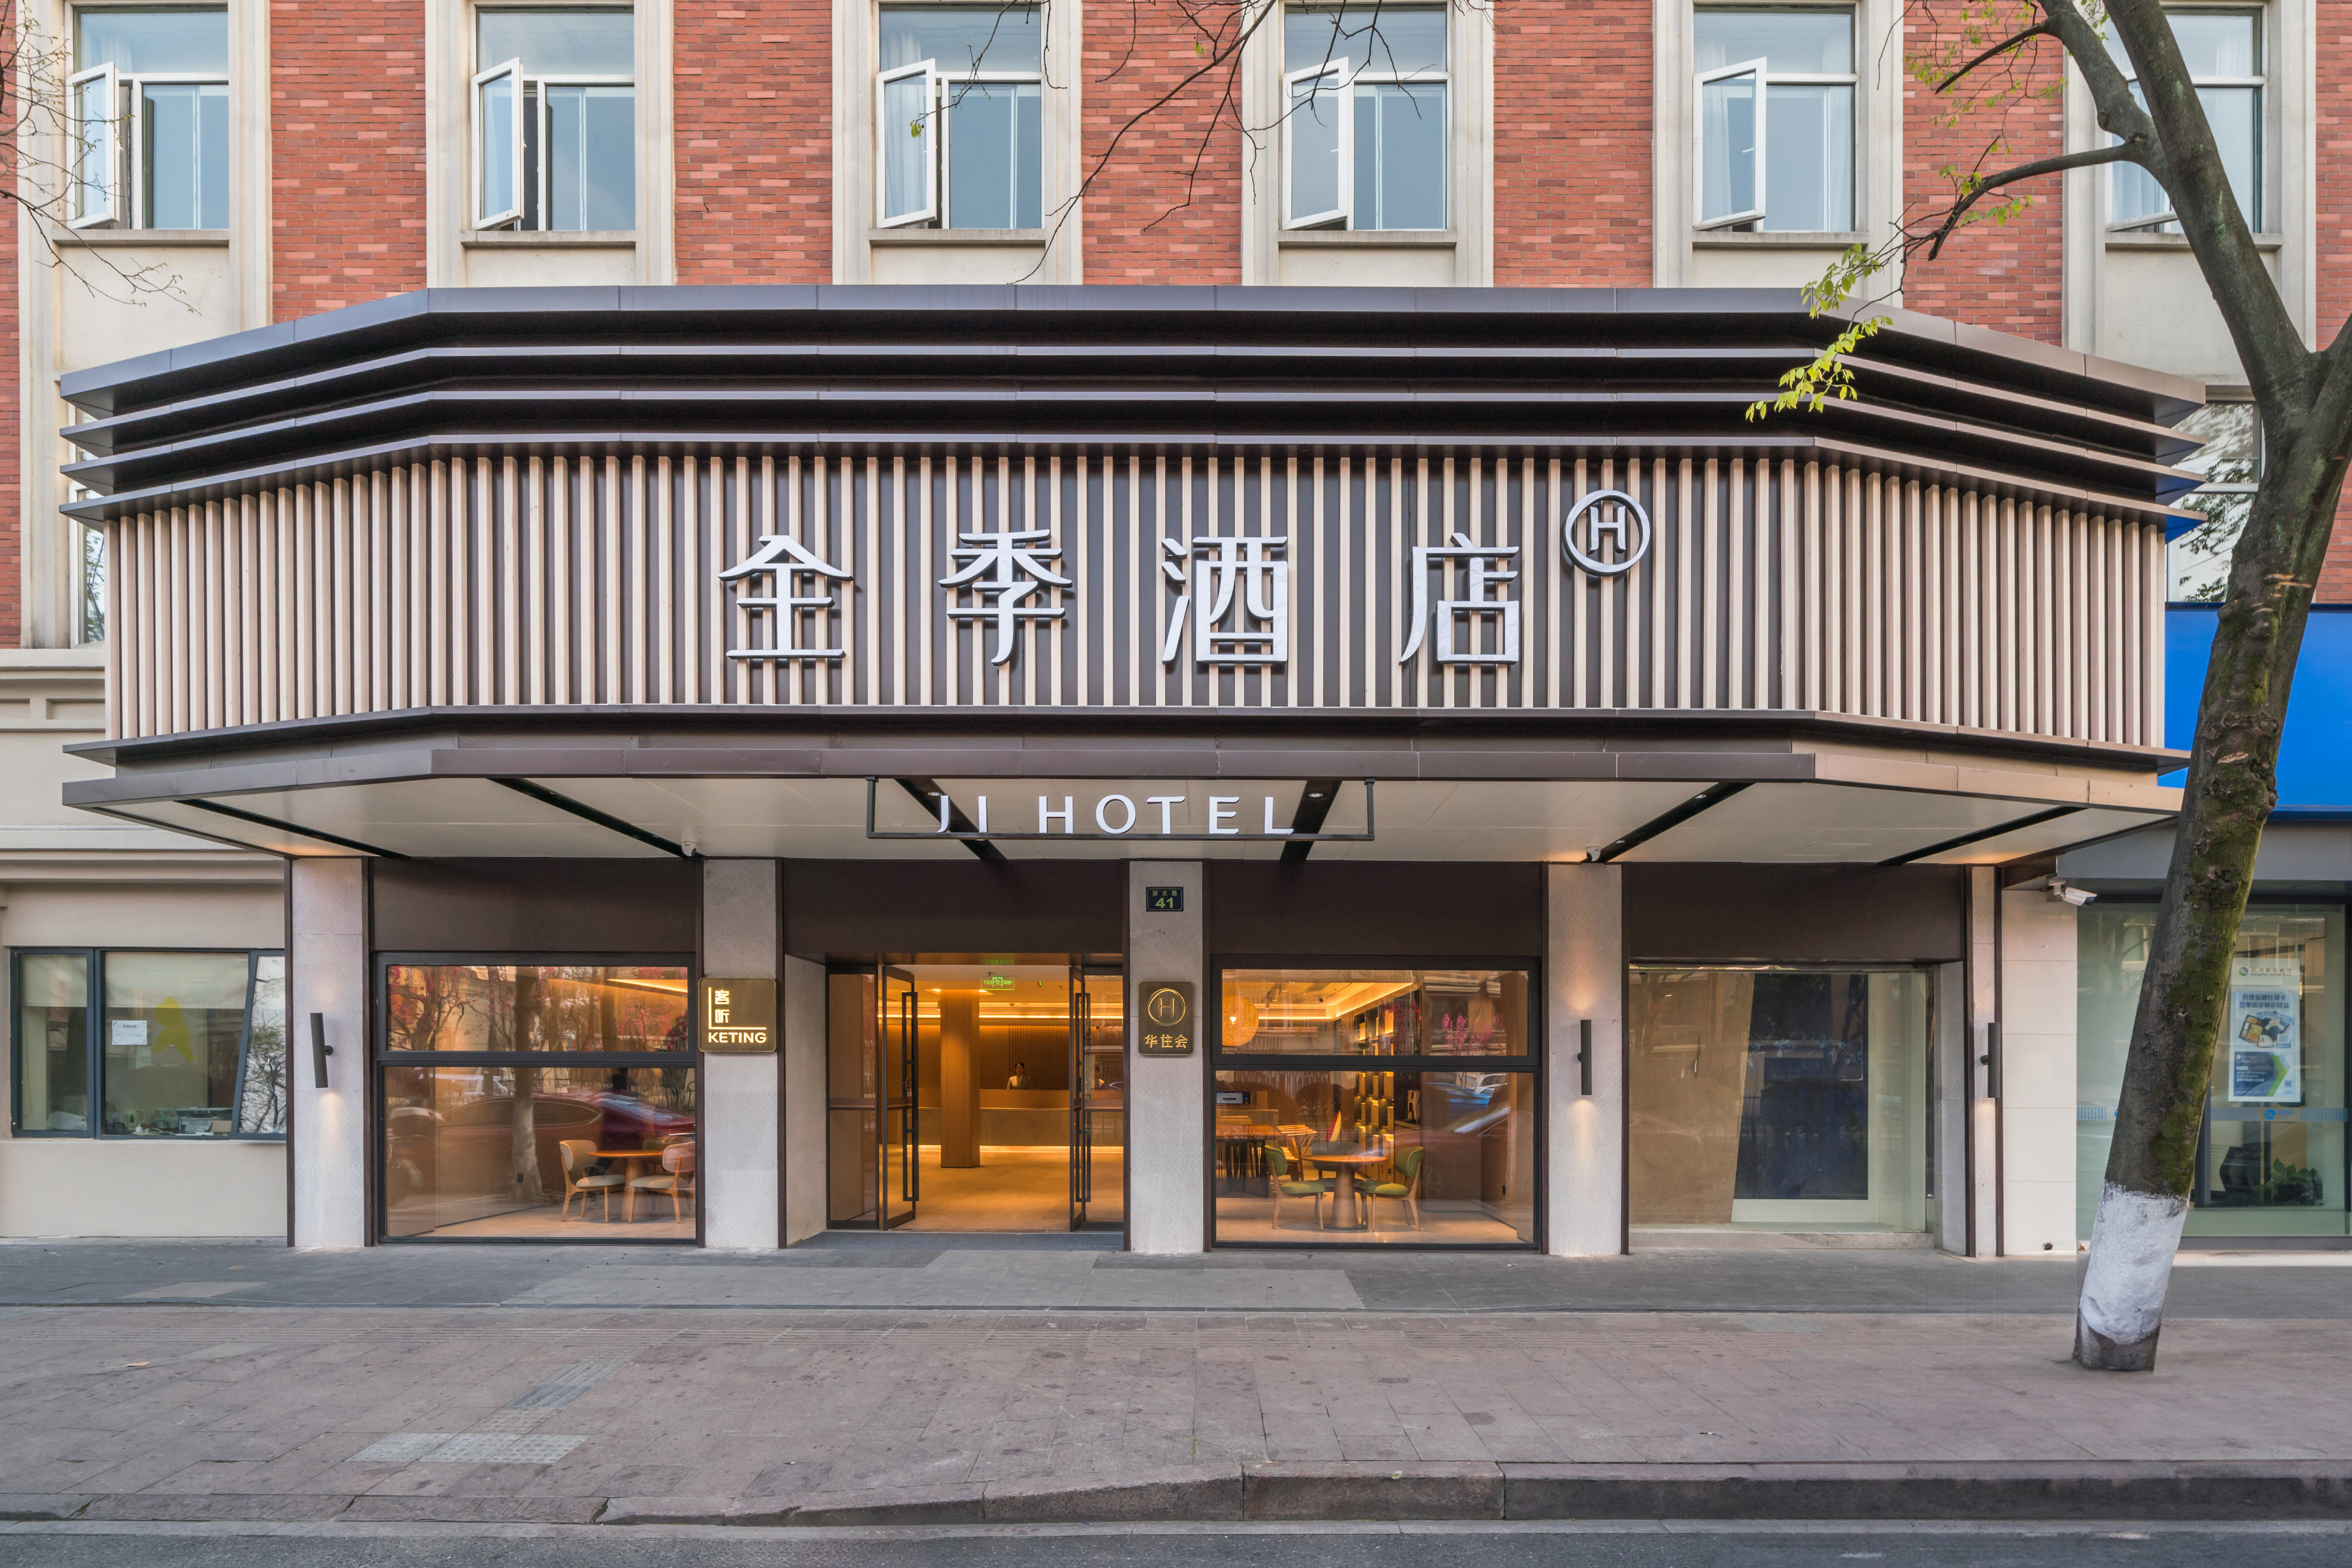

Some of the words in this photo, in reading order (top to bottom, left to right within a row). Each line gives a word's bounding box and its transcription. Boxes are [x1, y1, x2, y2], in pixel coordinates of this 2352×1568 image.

[718, 529, 1519, 666] 全季酒店
[937, 795, 988, 833] JI
[1039, 794, 1294, 834] HOTEL
[1155, 898, 1174, 908] 41
[714, 989, 730, 1023] 客听
[708, 1032, 767, 1043] KETING
[1144, 1033, 1188, 1049] 华住会
